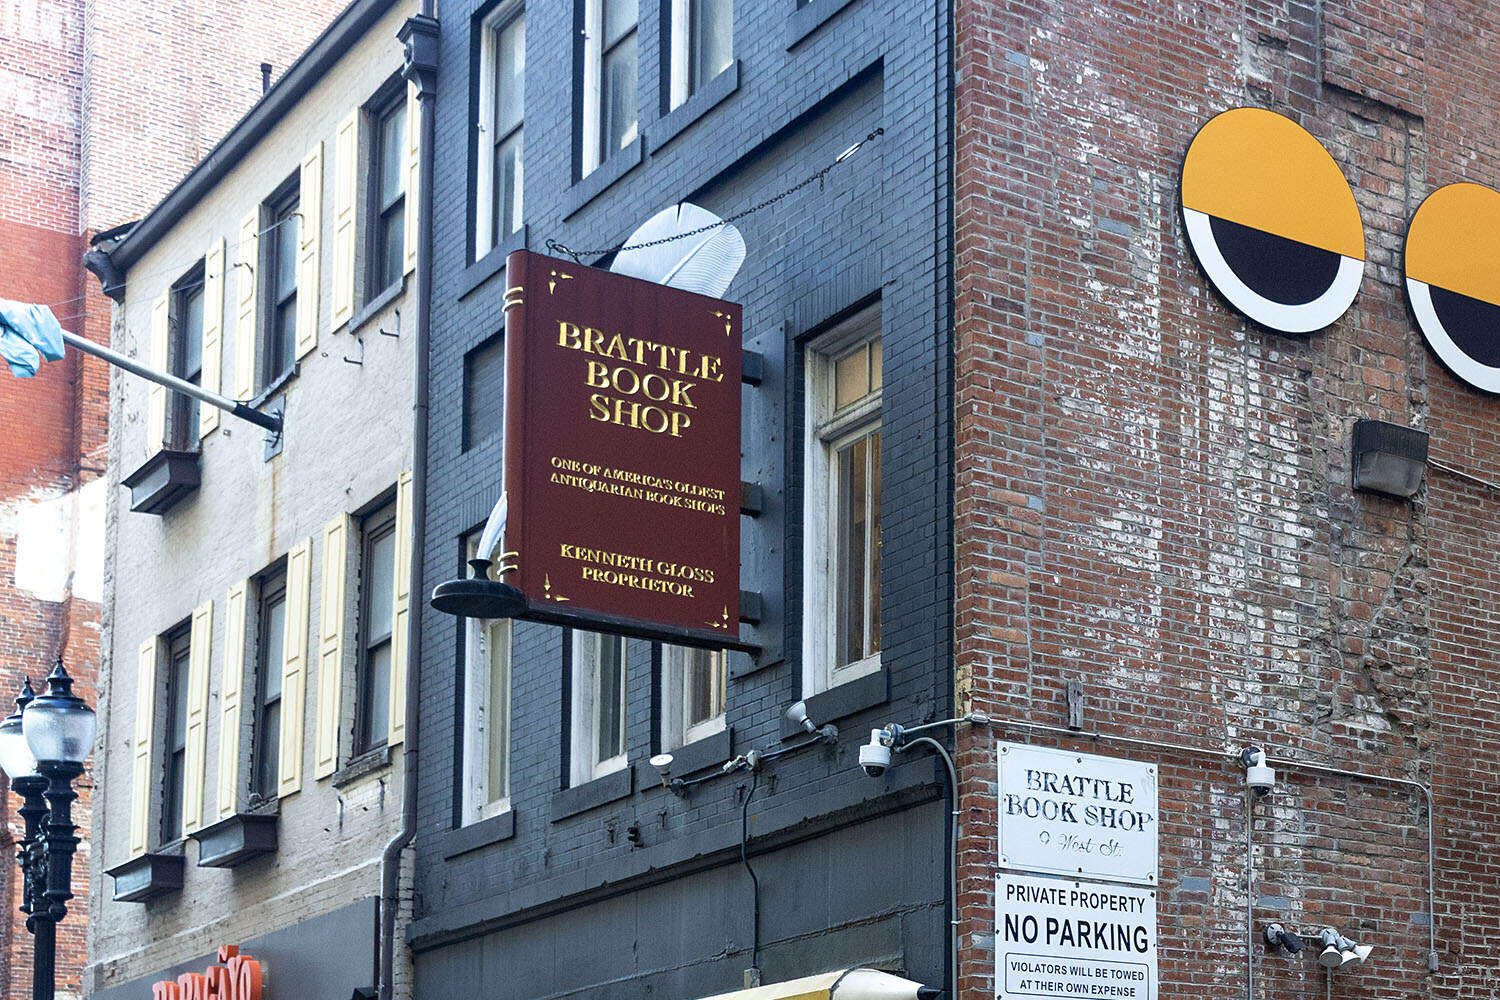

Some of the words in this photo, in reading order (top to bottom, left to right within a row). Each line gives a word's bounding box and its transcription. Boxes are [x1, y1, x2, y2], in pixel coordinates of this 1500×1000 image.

[556, 320, 724, 382] BRATTLE
[584, 360, 698, 409] BOOK
[590, 394, 691, 438] SHOP
[550, 472, 643, 499] ANTIQUARIAN
[646, 489, 682, 507] BOOK
[685, 496, 726, 516] SHOPS
[551, 456, 580, 473] ONE
[583, 463, 602, 476] OF
[604, 467, 672, 491] AMERICA'S
[675, 482, 725, 501] OLDEST
[560, 543, 654, 574] KENNETH
[657, 560, 715, 584] GLOSS
[582, 566, 696, 598] PROPRIETOR
[1024, 769, 1134, 804] BRATTLE
[1005, 794, 1078, 824] BOOK
[1084, 804, 1152, 832] SHOP
[1060, 833, 1094, 855] West
[1006, 884, 1066, 907] PRIVATE
[1070, 890, 1145, 914] PROPERTY
[1004, 914, 1038, 944] NO
[1046, 918, 1148, 954] PARKING
[1011, 962, 1068, 975] VIOLATORS
[1070, 966, 1094, 978] WILL
[1095, 968, 1108, 978] BE
[1110, 968, 1144, 981] TOWED
[1020, 979, 1033, 990] AT
[1035, 980, 1064, 992] THEIR
[1066, 982, 1090, 994] OWN
[1091, 984, 1136, 998] EXPENSE
